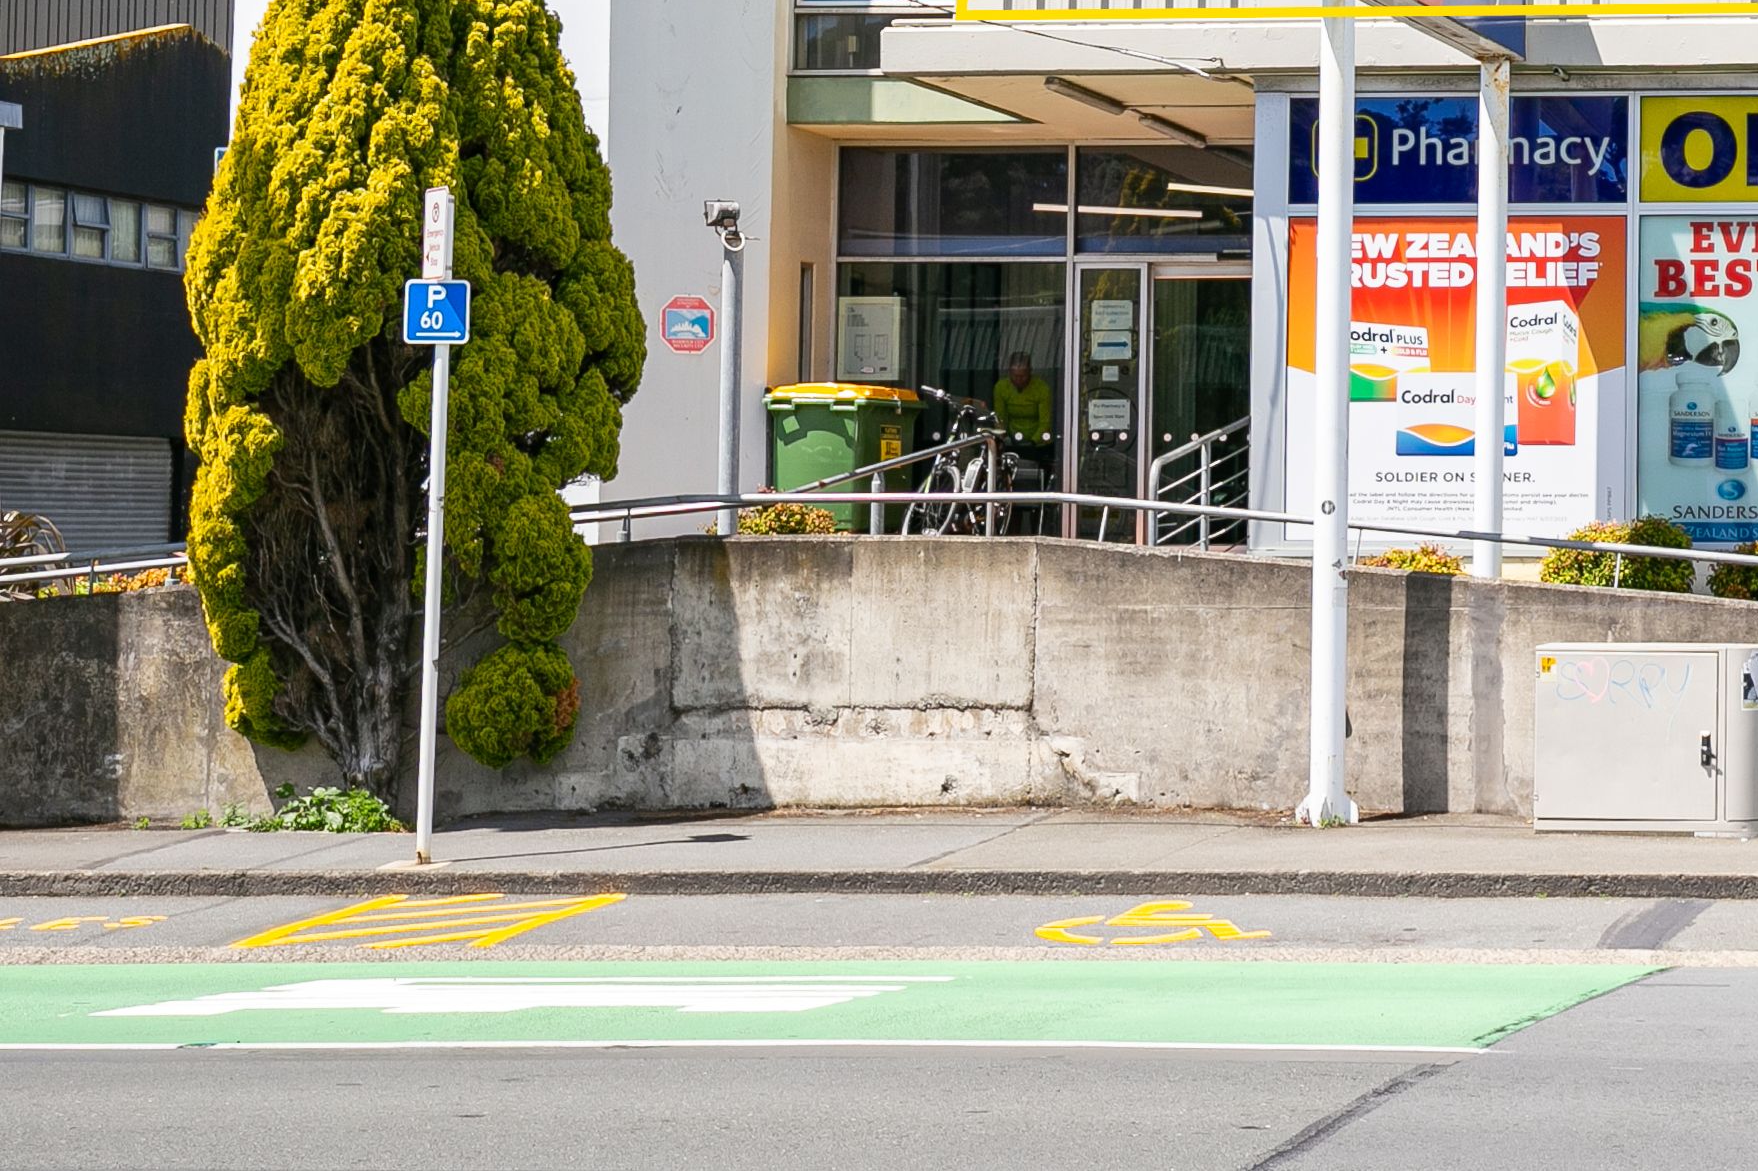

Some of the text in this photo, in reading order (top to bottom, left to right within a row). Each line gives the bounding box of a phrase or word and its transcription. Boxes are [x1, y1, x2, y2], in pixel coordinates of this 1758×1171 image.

[1393, 126, 1609, 176] Phamacy
[1350, 232, 1601, 259] EW ZEAAND'S
[1351, 262, 1599, 288] RUSTED ELIEF
[427, 285, 447, 309] P
[420, 311, 443, 330] 60
[1510, 312, 1557, 328] Codral
[1350, 327, 1423, 345] odral PLUS
[1402, 388, 1476, 406] Codral Day
[1376, 472, 1536, 482] SOLDIER ON SNER.
